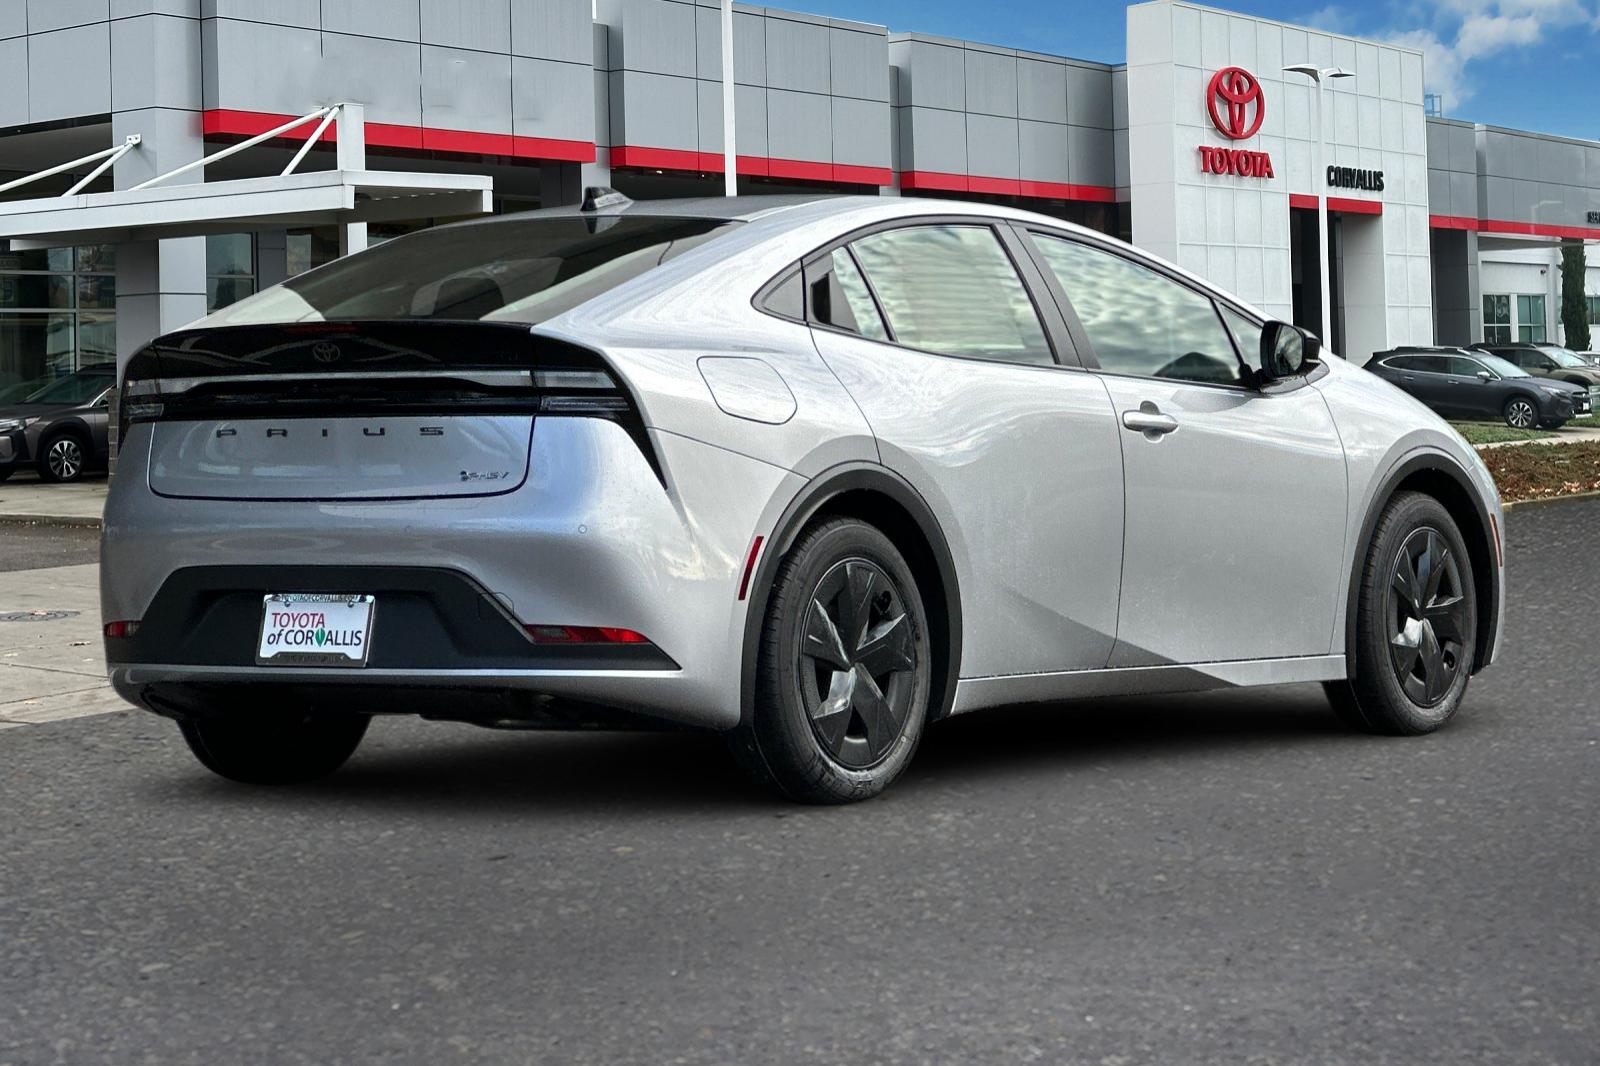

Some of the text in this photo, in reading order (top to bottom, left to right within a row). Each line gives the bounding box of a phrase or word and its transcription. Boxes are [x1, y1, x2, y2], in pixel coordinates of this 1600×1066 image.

[1199, 146, 1275, 178] TOYOTA
[1327, 165, 1385, 191] CORVALLIS
[216, 427, 444, 437] PRIUS
[272, 612, 326, 628] TOYOTA
[267, 629, 284, 646] of
